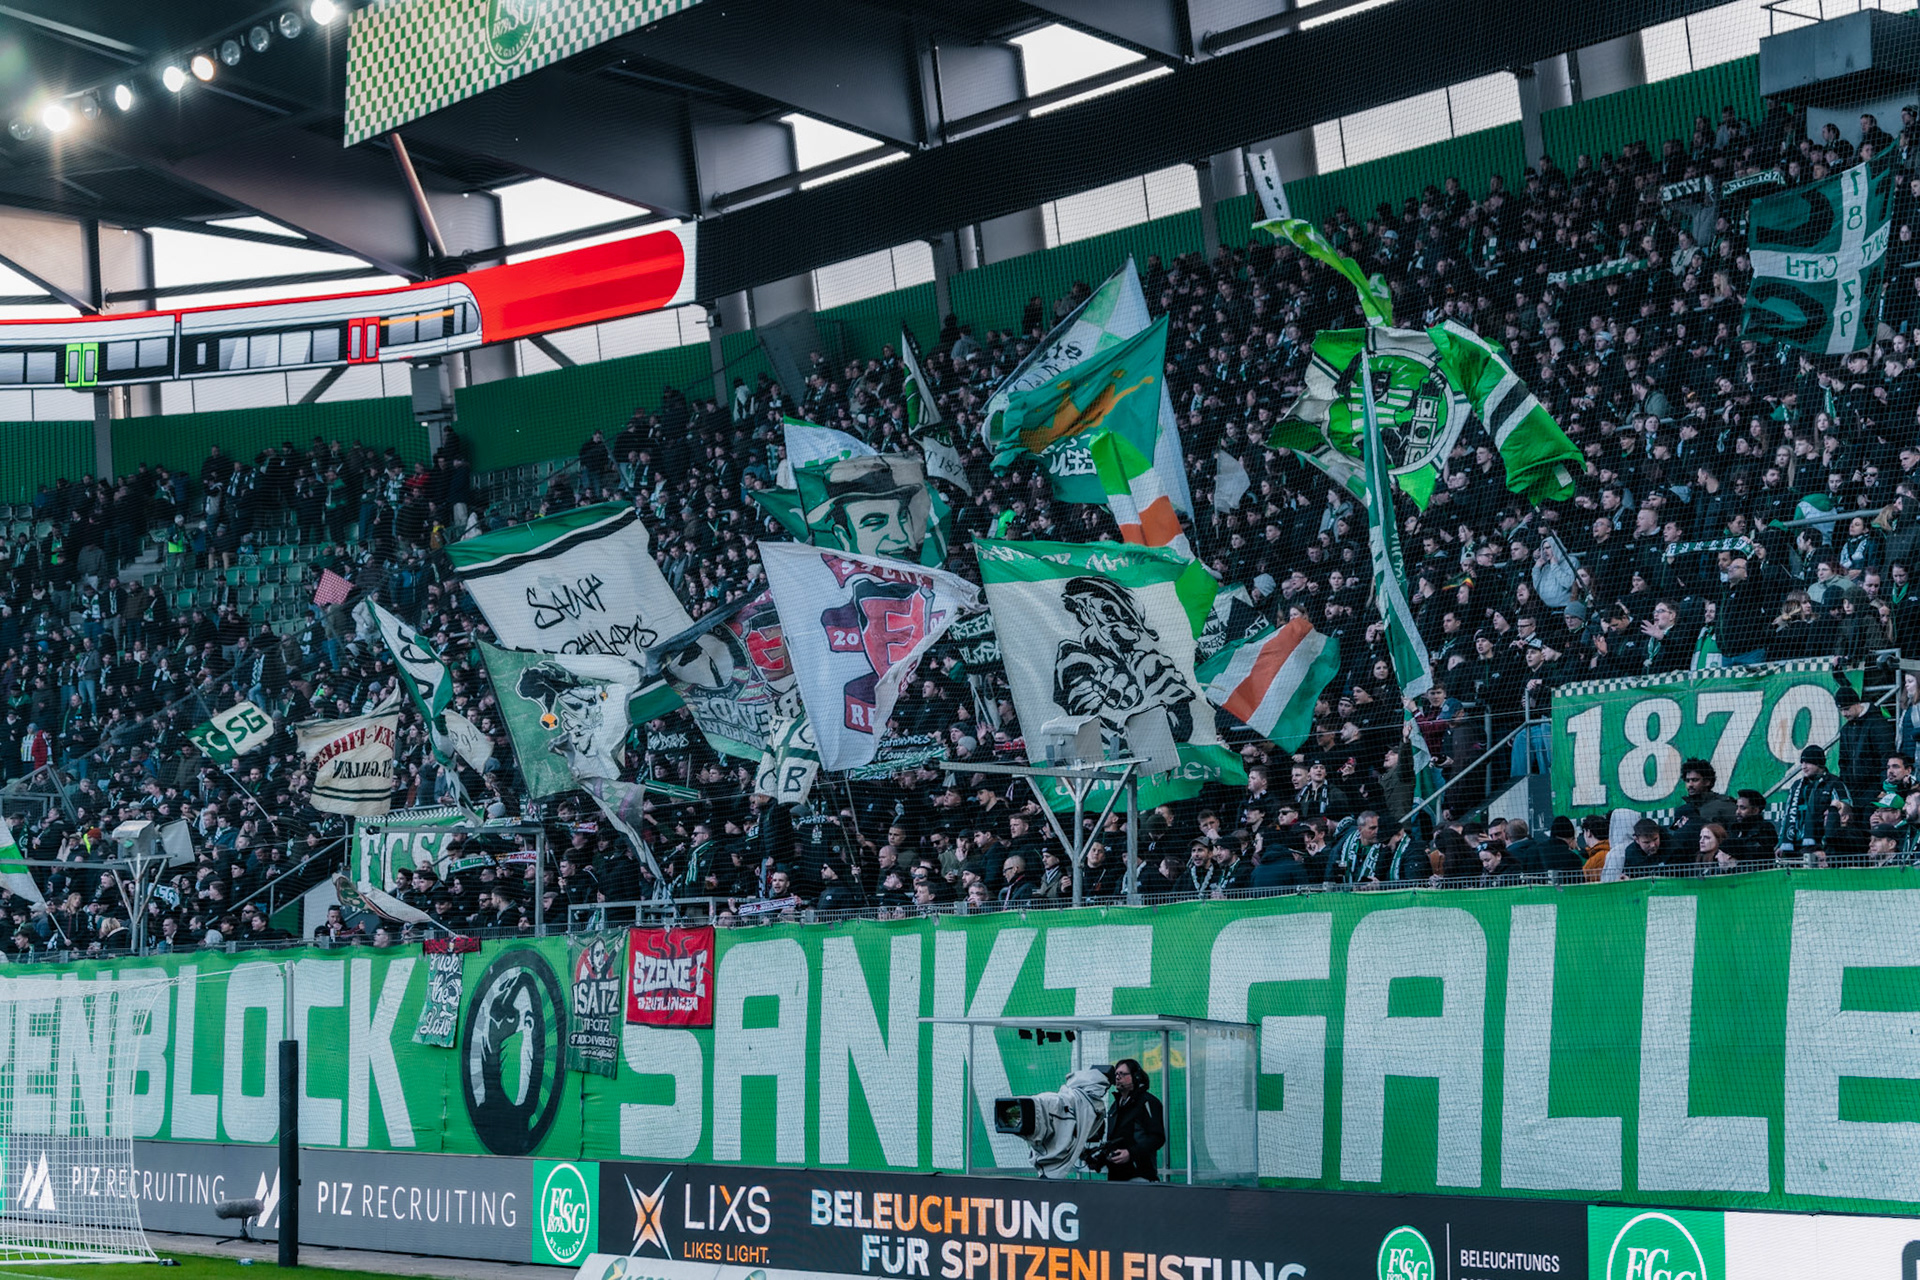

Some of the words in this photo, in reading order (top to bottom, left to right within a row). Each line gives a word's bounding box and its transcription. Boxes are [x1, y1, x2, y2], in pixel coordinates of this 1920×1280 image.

[190, 706, 268, 758] FCSG
[1567, 684, 1840, 806] 1879
[618, 923, 1153, 1170] SANKT
[1206, 889, 1920, 1201] GALLE
[72, 1166, 100, 1197] PIZ
[107, 1168, 225, 1206] RECRUITING
[318, 1181, 353, 1216] PIZ
[362, 1184, 517, 1228] RECRUITING
[684, 1183, 772, 1235] LIXS
[811, 1188, 1080, 1242] BELEUCHTUNG
[683, 1240, 722, 1261] LIKES
[726, 1244, 771, 1265] LIGHT.
[861, 1234, 930, 1277] FÜR
[1460, 1249, 1560, 1273] BELEUCHTUNGS
